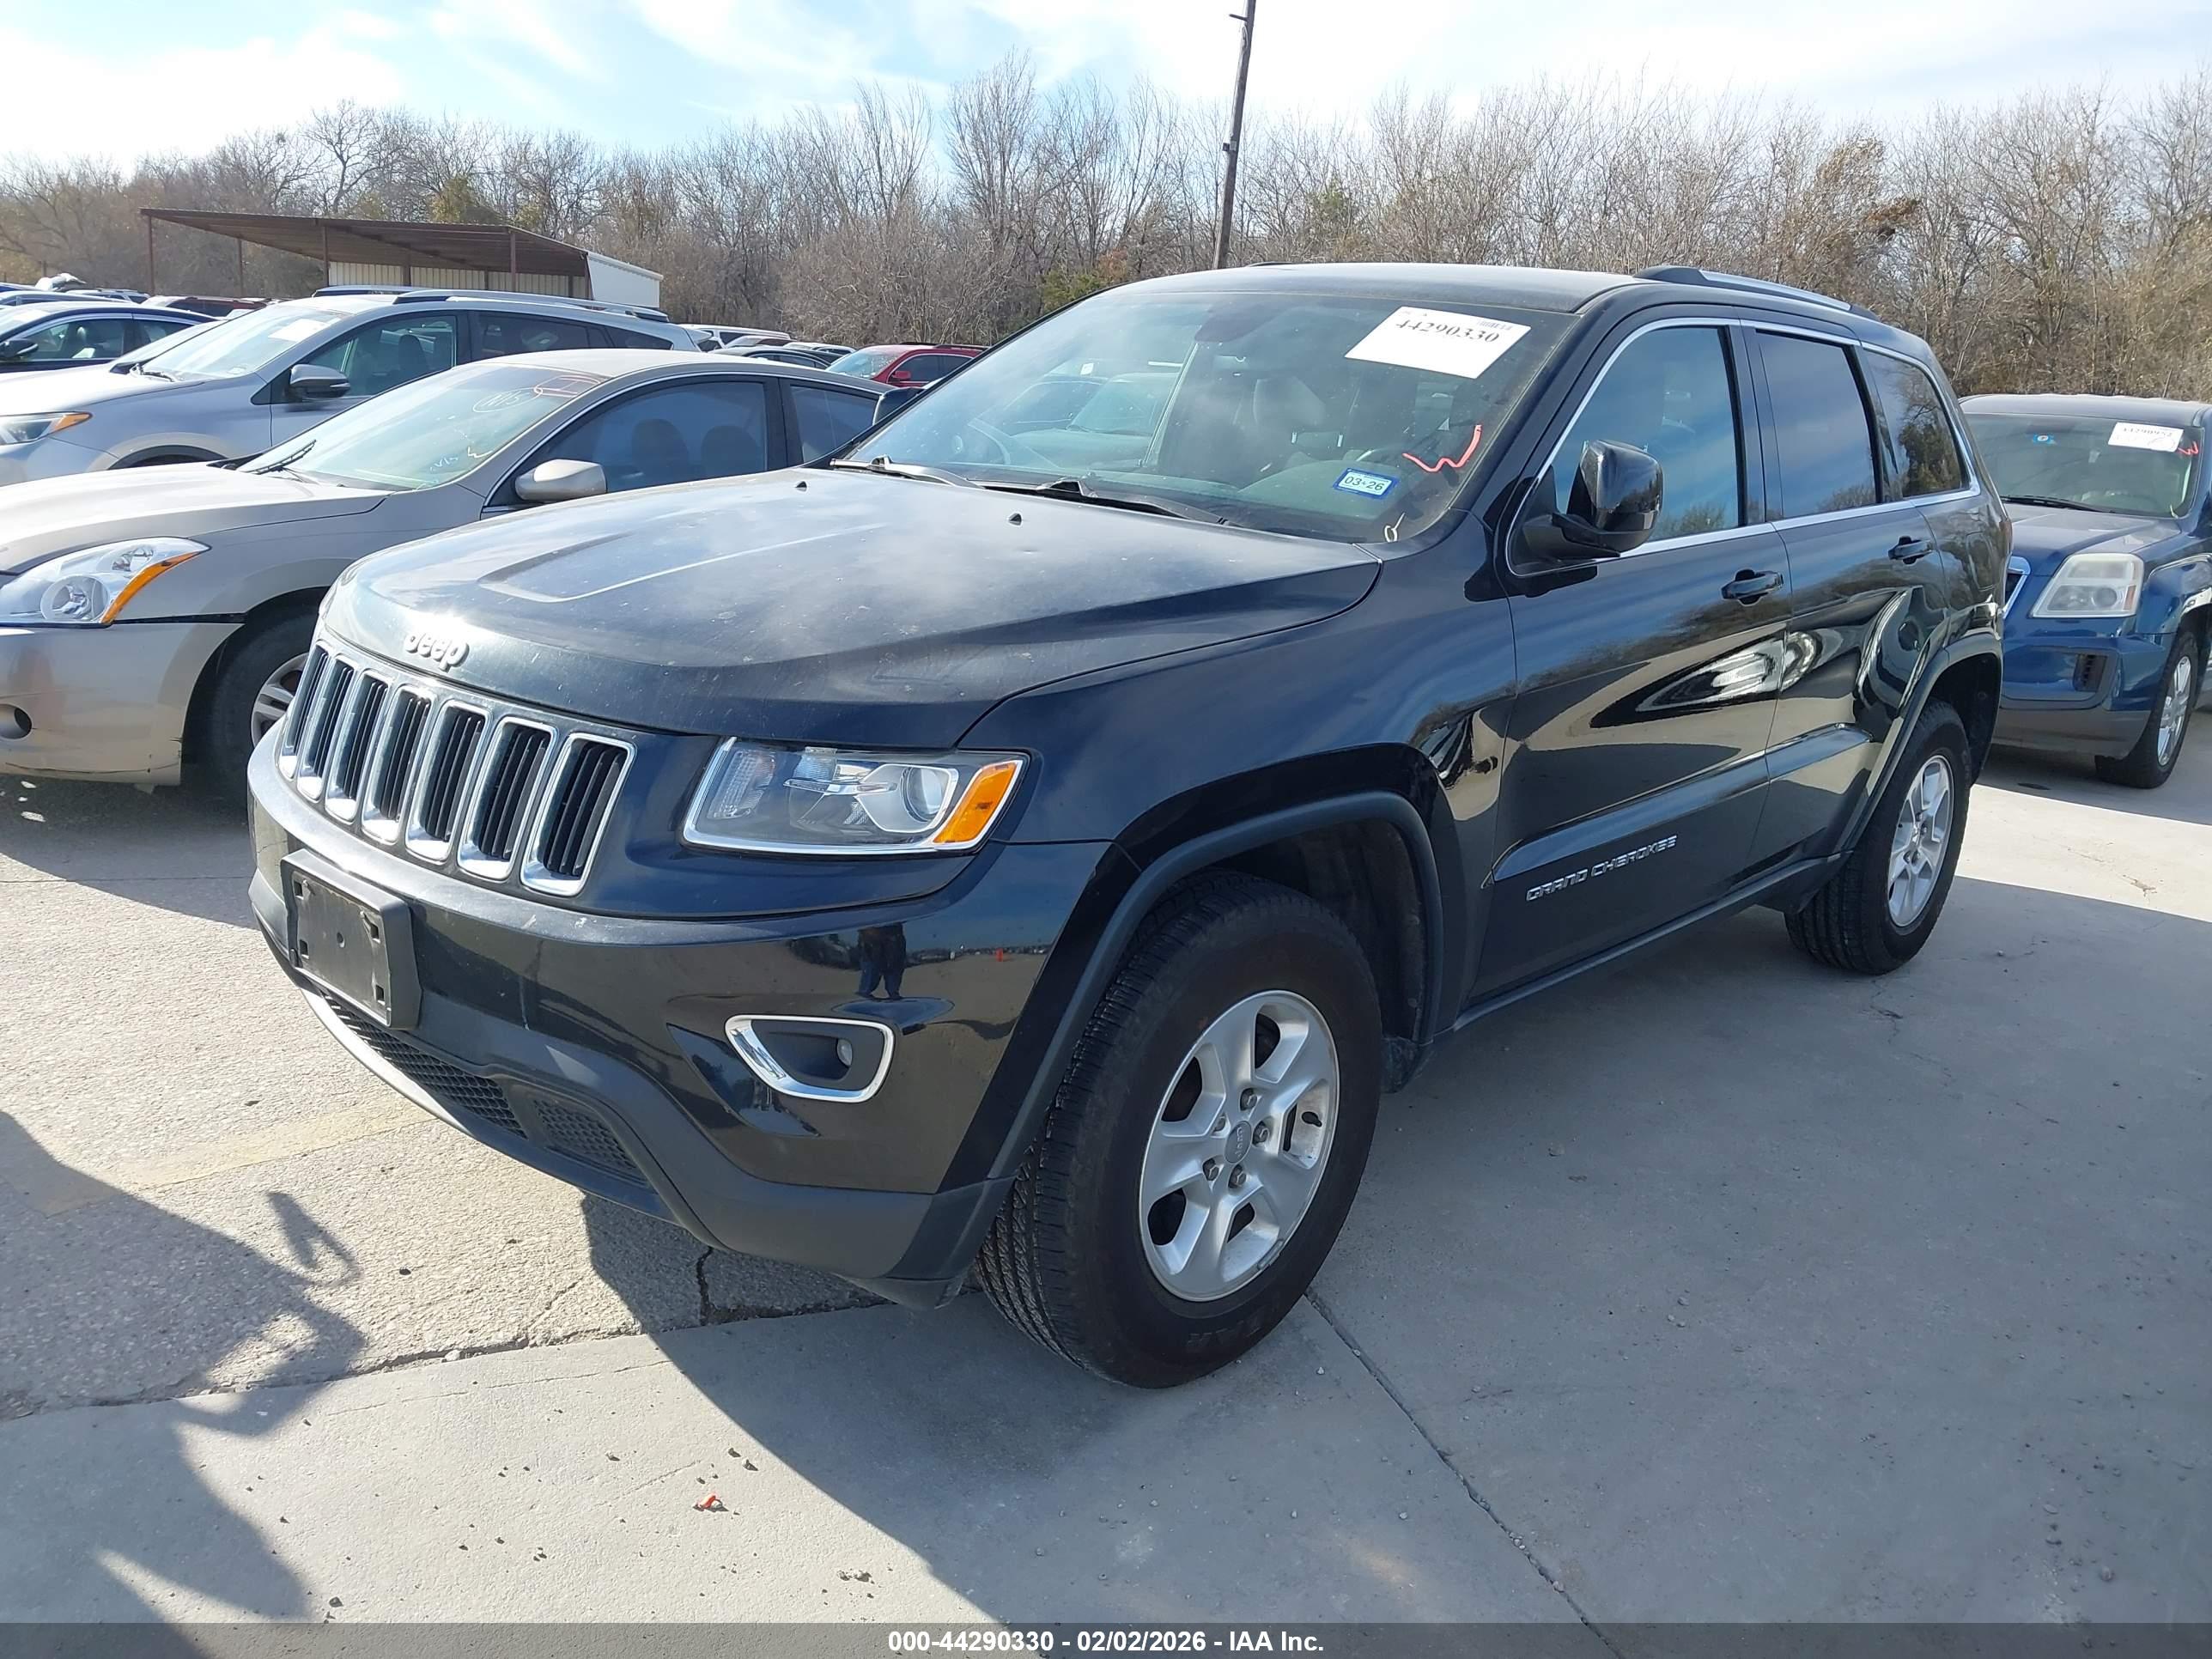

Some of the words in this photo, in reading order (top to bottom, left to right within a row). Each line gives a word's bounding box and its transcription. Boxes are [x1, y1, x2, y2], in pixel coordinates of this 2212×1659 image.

[1396, 319, 1500, 343] 44290330
[404, 631, 470, 673] Jeep
[1526, 869, 1588, 902] GRAND
[1590, 835, 1677, 878] CHEROKEE
